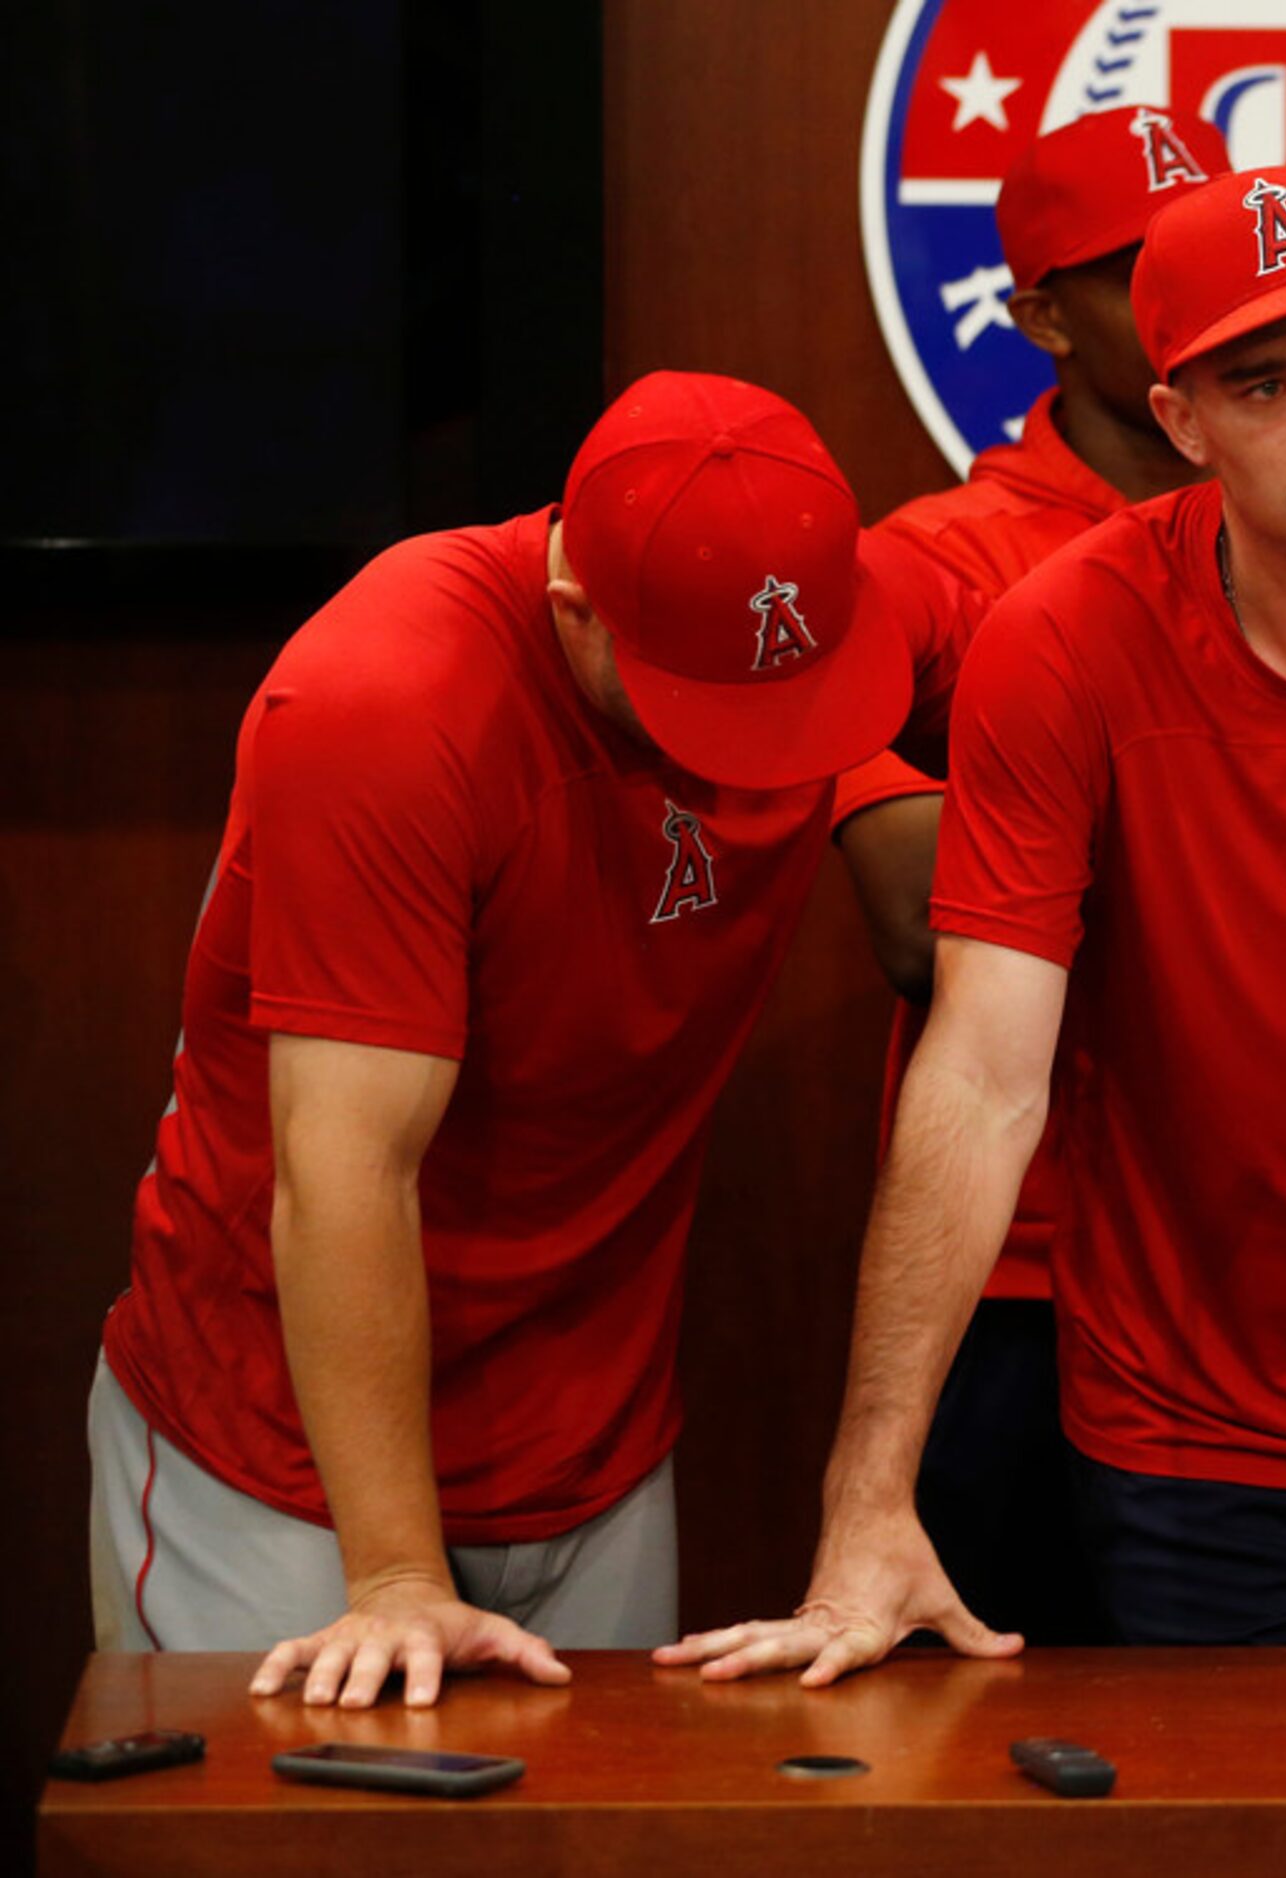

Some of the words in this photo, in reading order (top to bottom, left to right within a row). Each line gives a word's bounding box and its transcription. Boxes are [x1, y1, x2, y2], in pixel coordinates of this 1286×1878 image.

[1130, 108, 1209, 193] A
[750, 575, 817, 671] A
[649, 798, 718, 924] A
